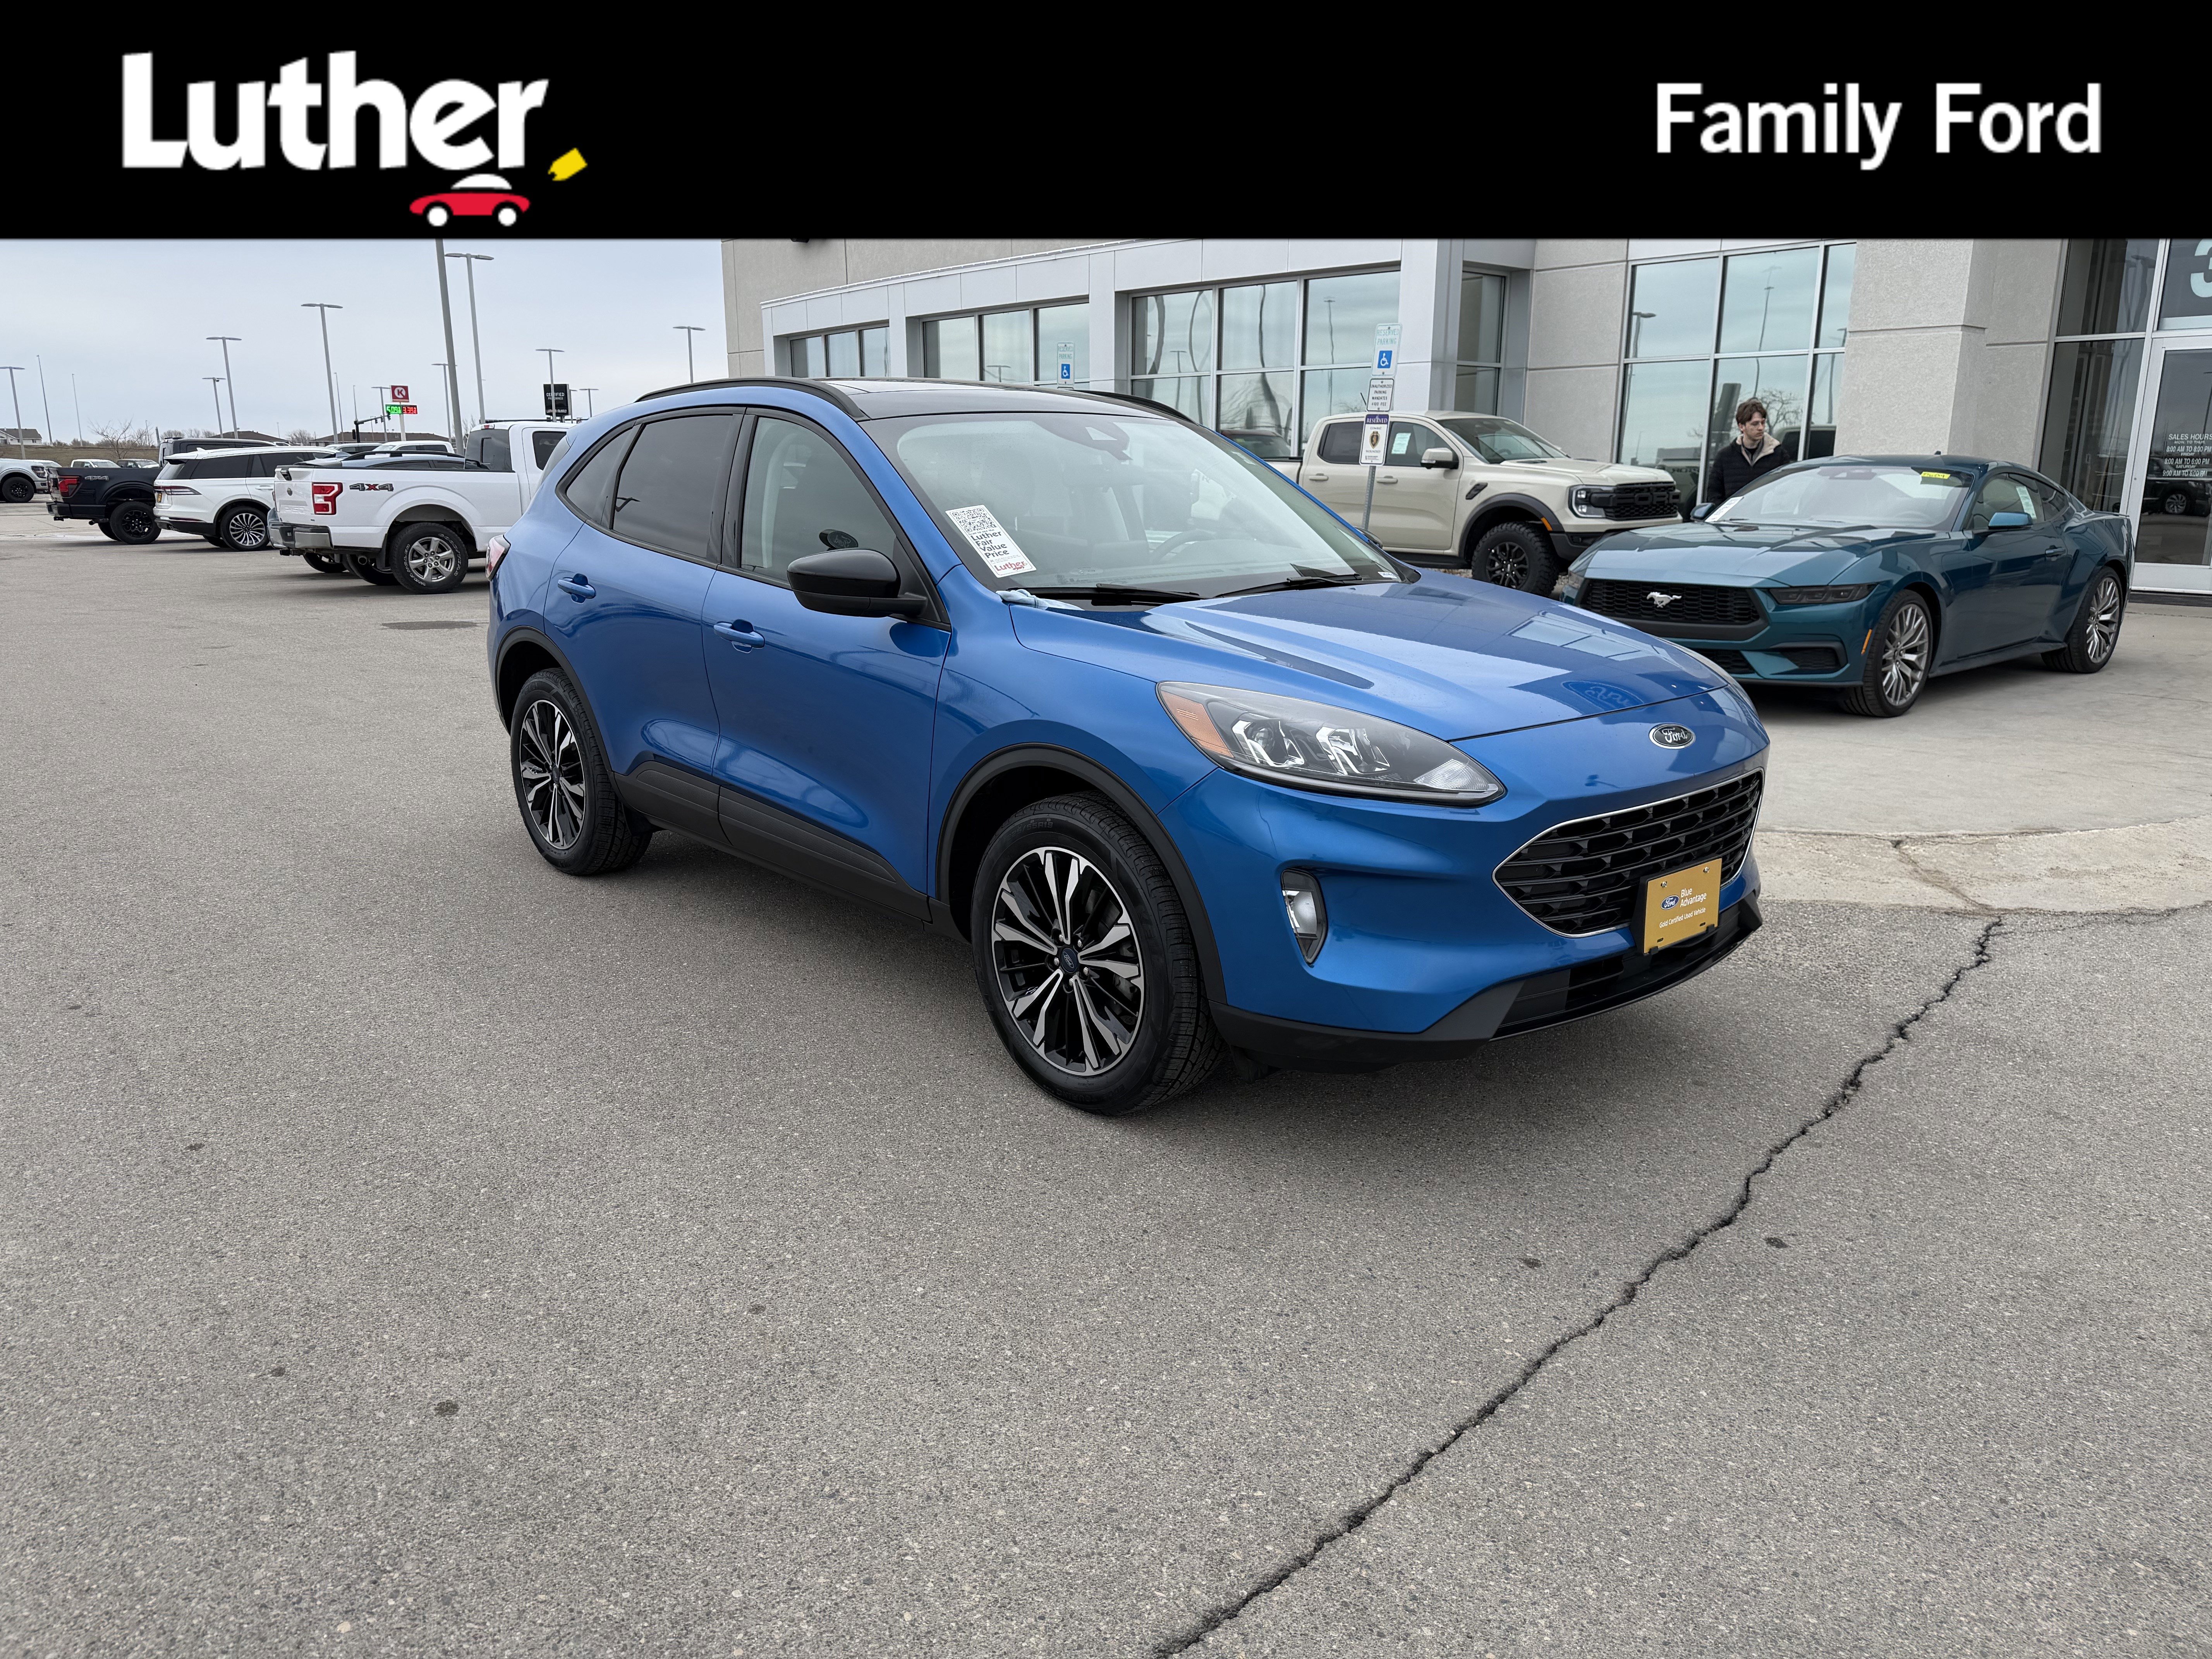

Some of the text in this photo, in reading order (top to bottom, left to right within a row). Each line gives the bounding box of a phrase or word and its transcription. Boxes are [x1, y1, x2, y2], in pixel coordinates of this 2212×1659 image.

[970, 531, 1002, 541] Luther
[975, 538, 993, 546] Fair
[979, 543, 1008, 552] Value
[984, 549, 1010, 558] Price
[994, 561, 1024, 571] Luther
[1662, 728, 1688, 743] Ford
[1681, 888, 1692, 898] Blue
[1664, 897, 1676, 908] Ford
[1680, 893, 1707, 907] Advantage
[1659, 907, 1706, 928] Gold Certified Used Vehicle
